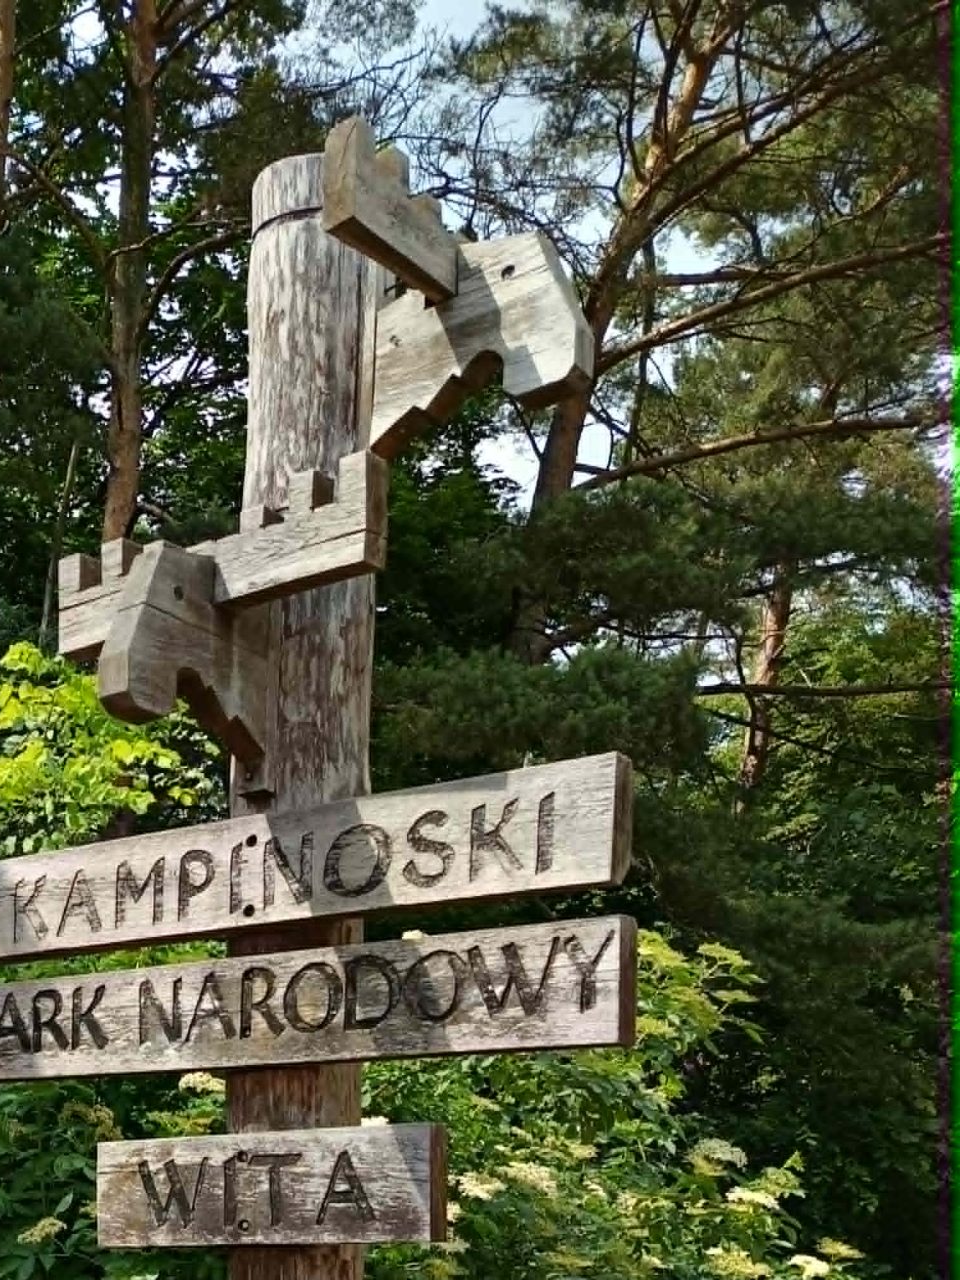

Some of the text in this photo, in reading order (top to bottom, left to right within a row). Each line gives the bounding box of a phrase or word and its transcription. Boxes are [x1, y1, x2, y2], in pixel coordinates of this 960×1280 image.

[12, 791, 555, 943] KAMPINOSKI
[138, 929, 615, 1049] NARODOWY
[138, 1150, 377, 1229] WITA
